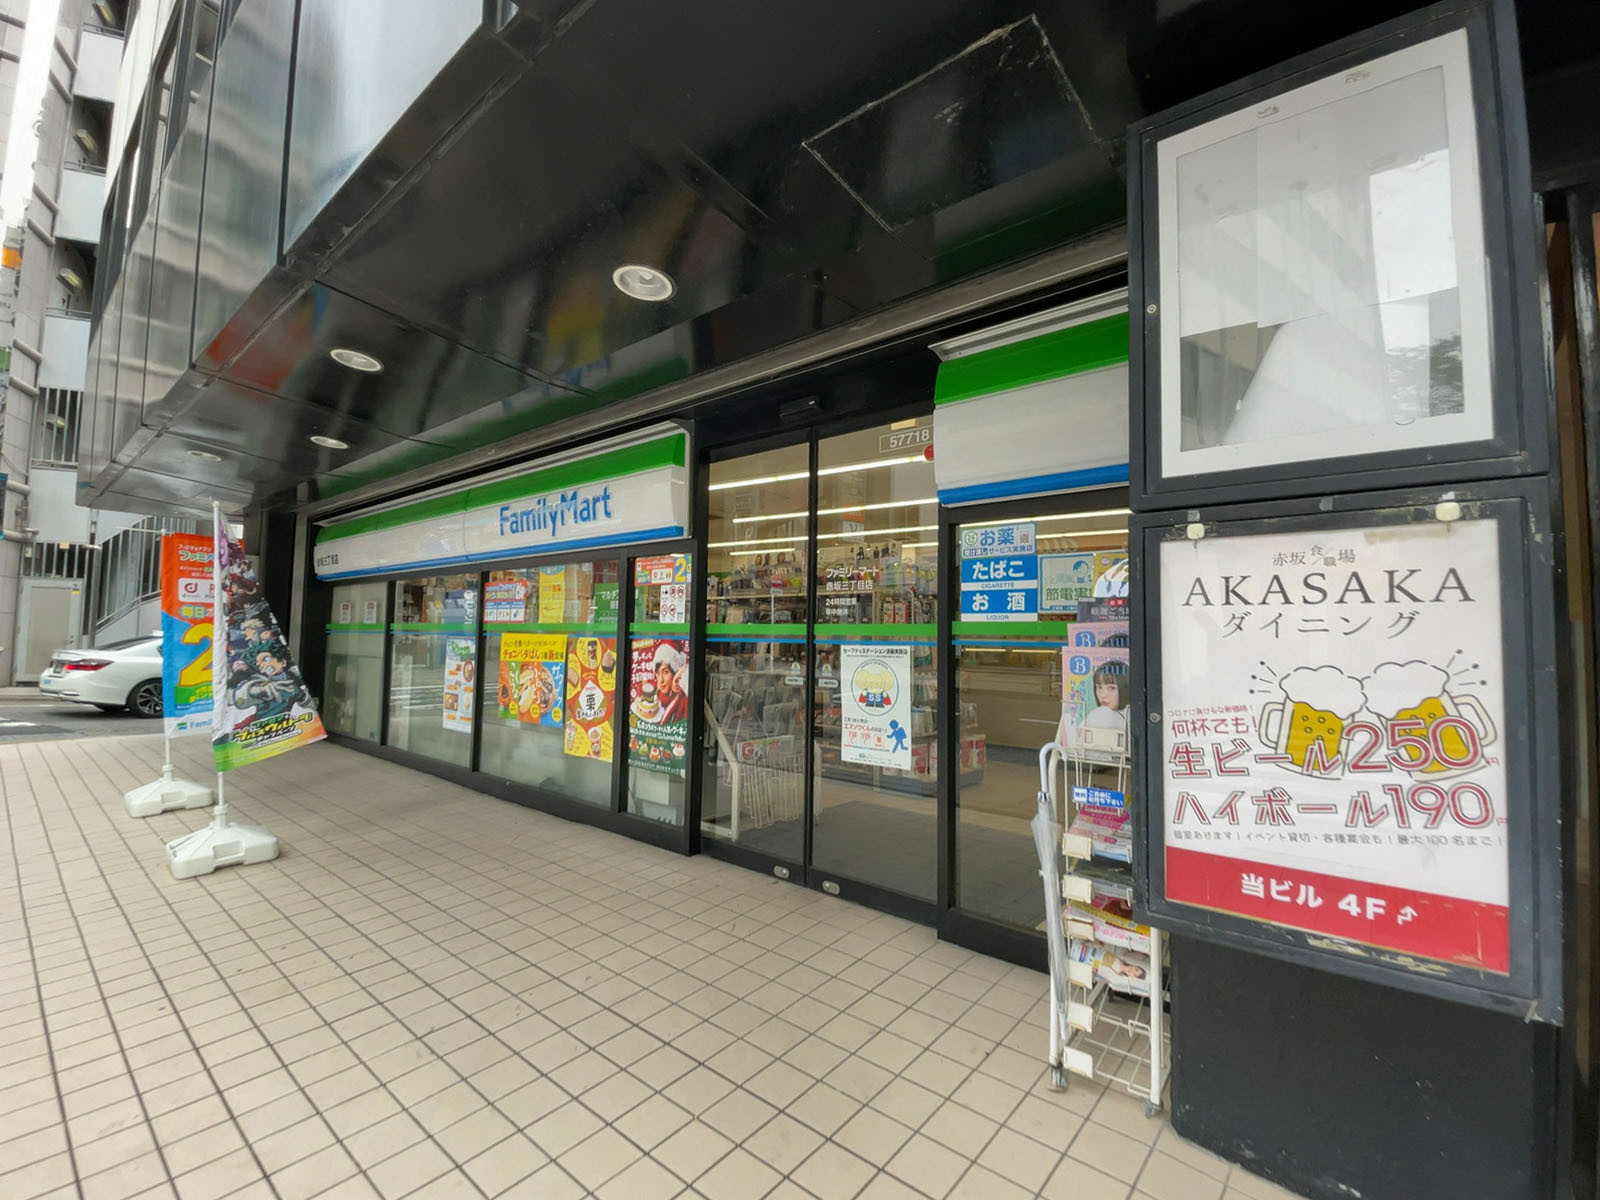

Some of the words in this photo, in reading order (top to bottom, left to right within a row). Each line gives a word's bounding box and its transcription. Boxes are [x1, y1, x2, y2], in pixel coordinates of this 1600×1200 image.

[890, 428, 930, 448] 57718
[499, 486, 612, 537] FamilyMart
[980, 527, 1015, 547] お薬
[675, 558, 688, 582] 2
[826, 566, 879, 579] ファミリーマート
[972, 560, 1025, 580] たばこ
[826, 580, 873, 591] 赤坂三丁目店
[1047, 587, 1092, 601] 節電実
[1182, 566, 1476, 607] AKASAKA
[971, 592, 1025, 611] お酒
[1221, 610, 1420, 640] ダイニング
[1171, 715, 1259, 737] 何杯でも！
[1240, 872, 1324, 909] 当ビル
[1338, 893, 1386, 921] 4F
